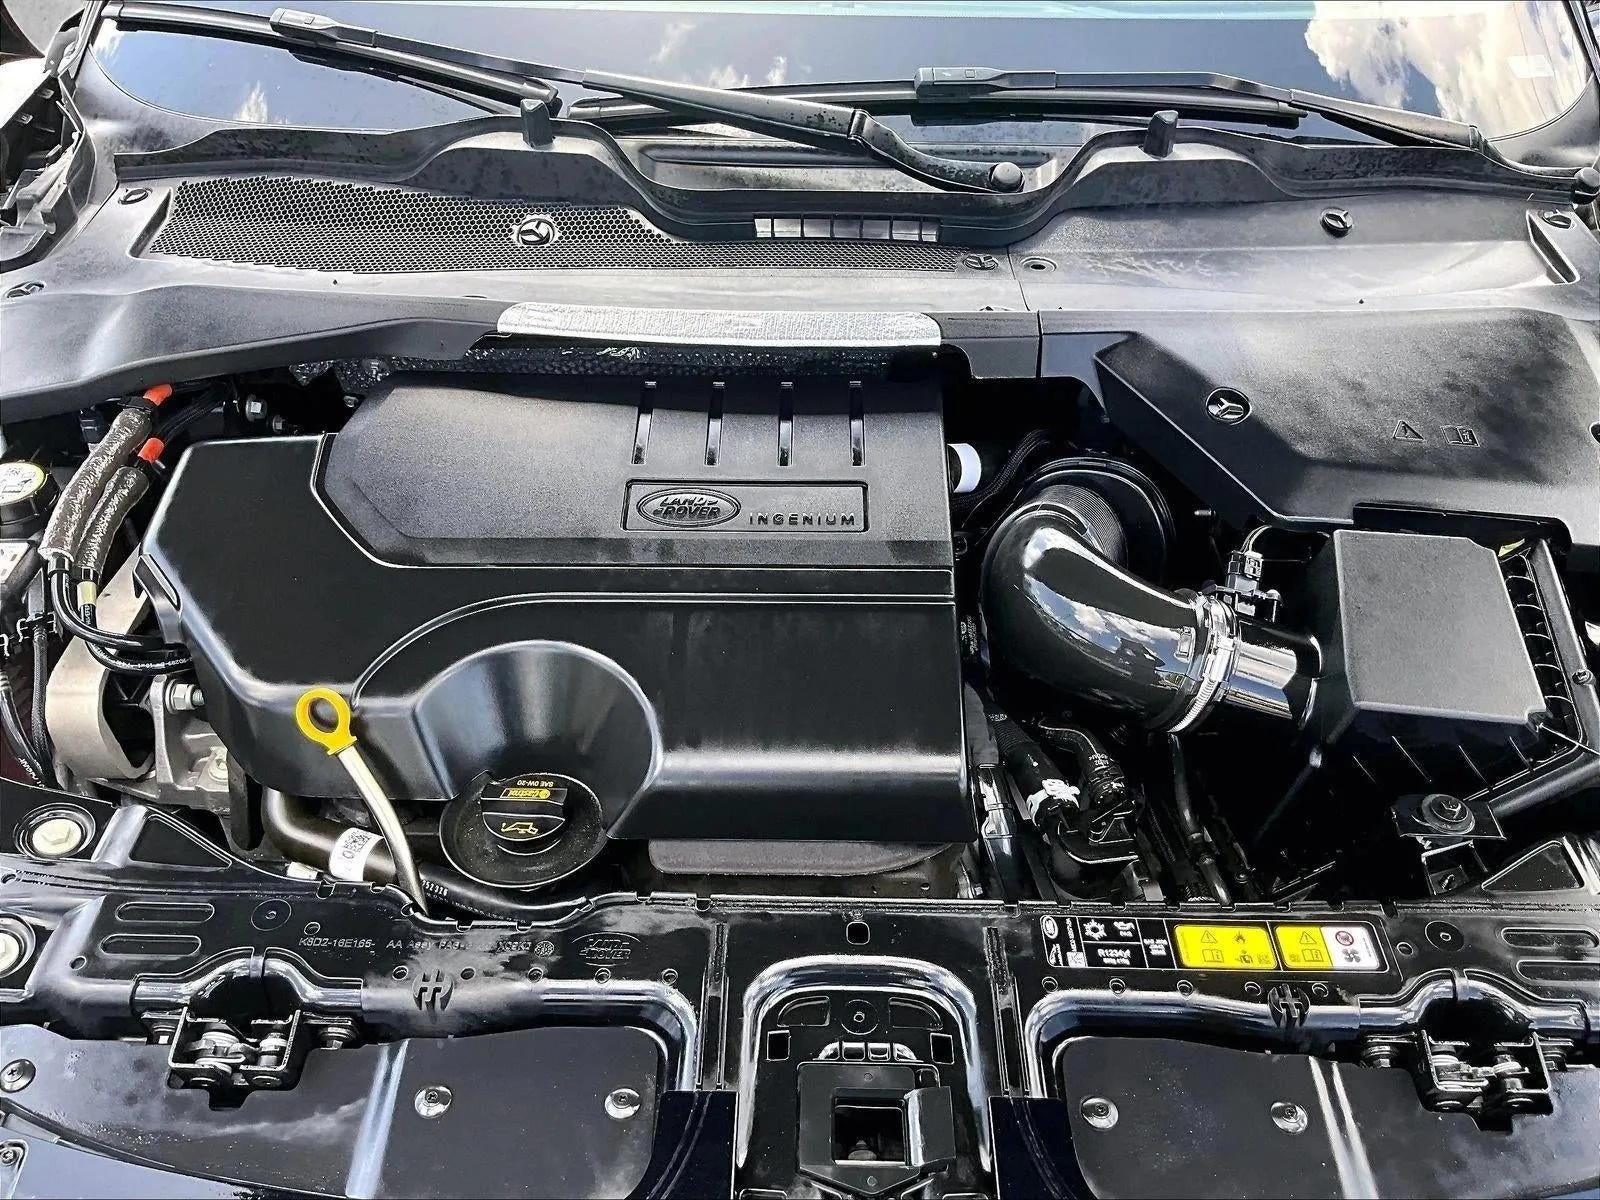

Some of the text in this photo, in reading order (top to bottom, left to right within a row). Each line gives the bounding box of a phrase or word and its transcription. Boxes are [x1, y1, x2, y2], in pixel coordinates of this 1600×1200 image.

[660, 497, 709, 506] LAND
[662, 506, 721, 519] ROVER
[749, 512, 855, 526] INGENIUM
